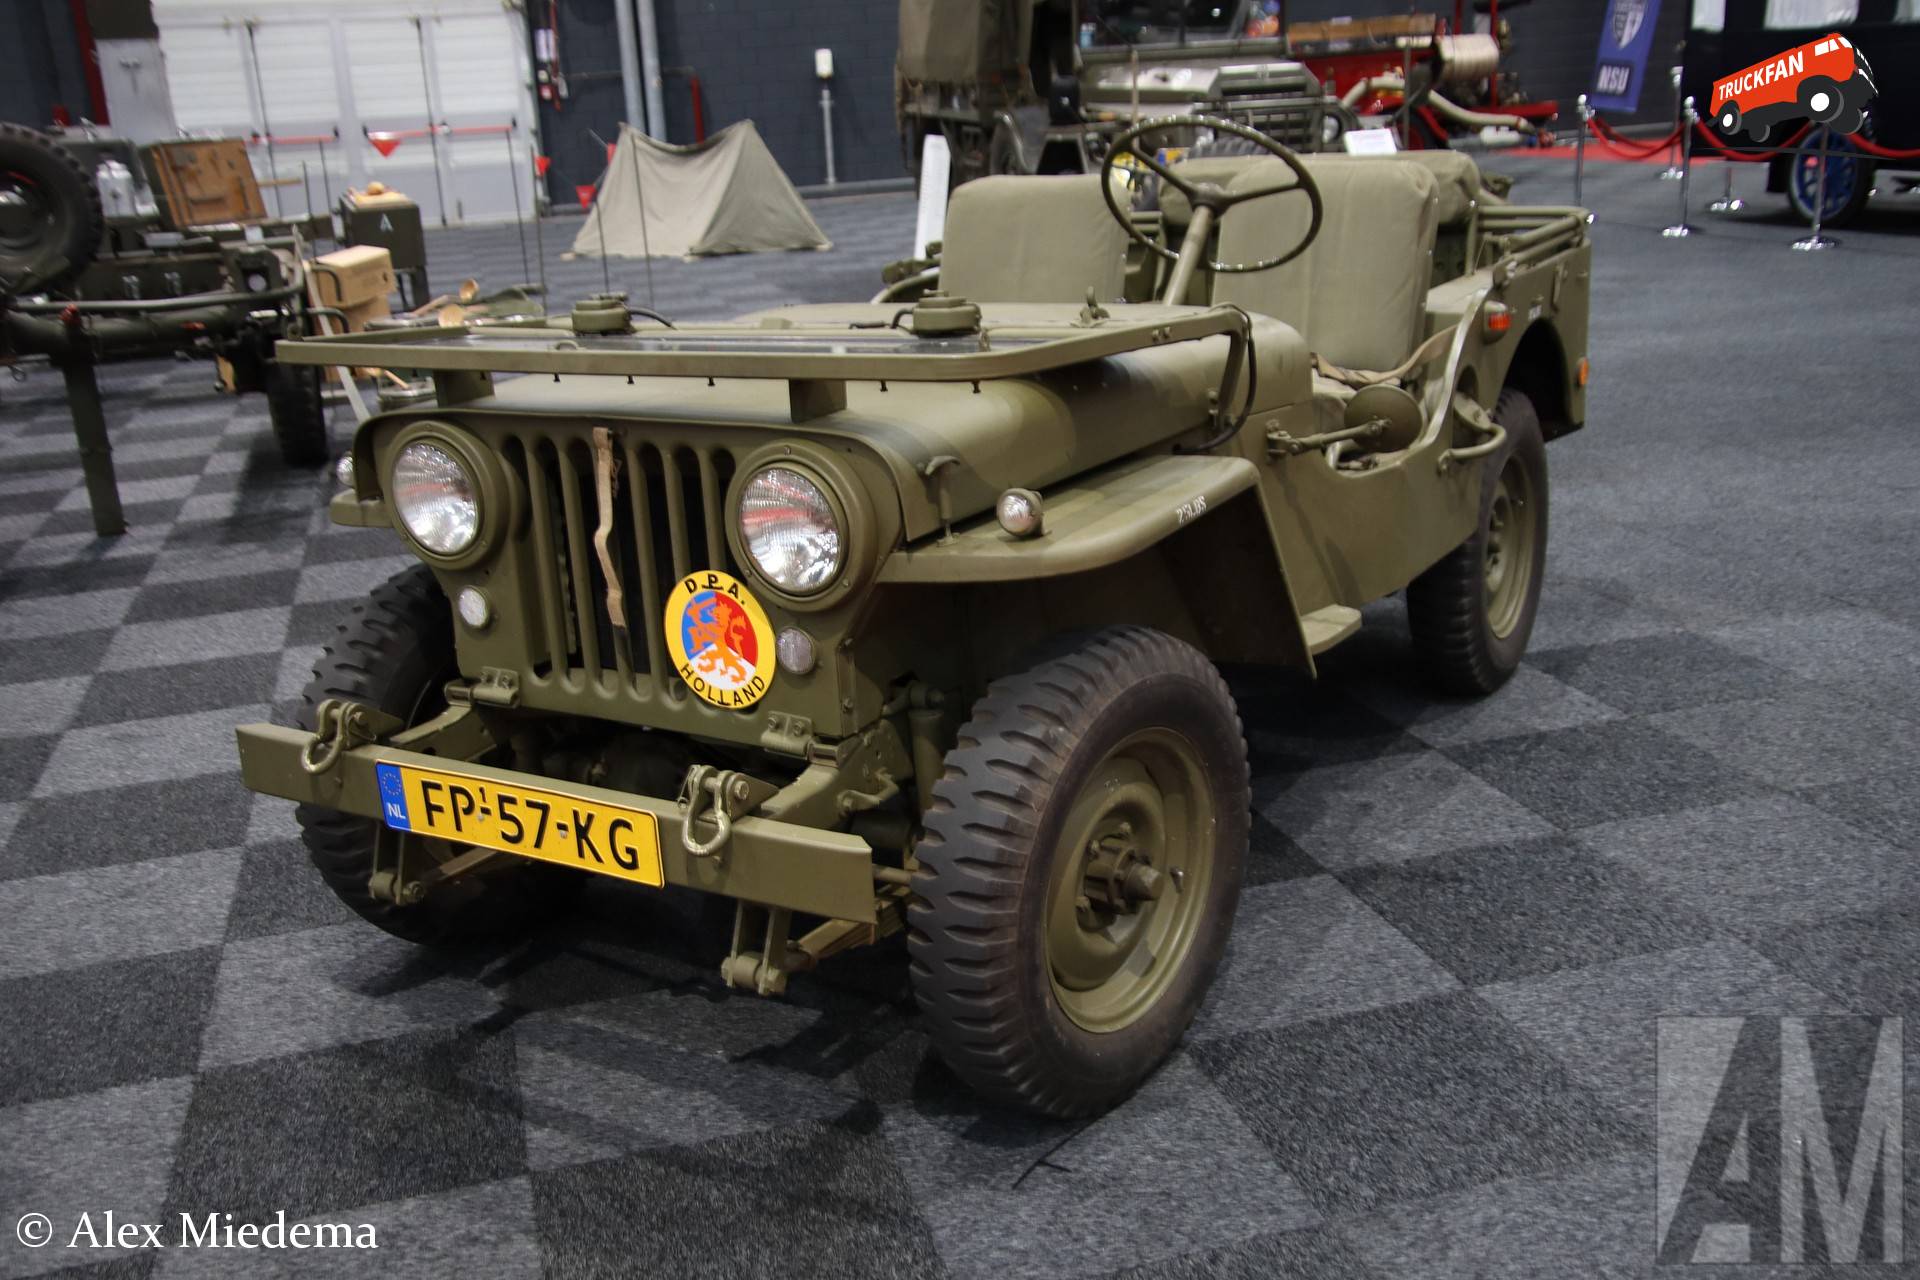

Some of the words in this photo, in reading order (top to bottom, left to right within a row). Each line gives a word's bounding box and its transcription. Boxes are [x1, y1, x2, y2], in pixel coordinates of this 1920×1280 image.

[1597, 65, 1630, 94] NSU
[681, 664, 765, 706] HOLLAND
[386, 802, 406, 819] NL
[420, 779, 640, 871] FP-57-KG
